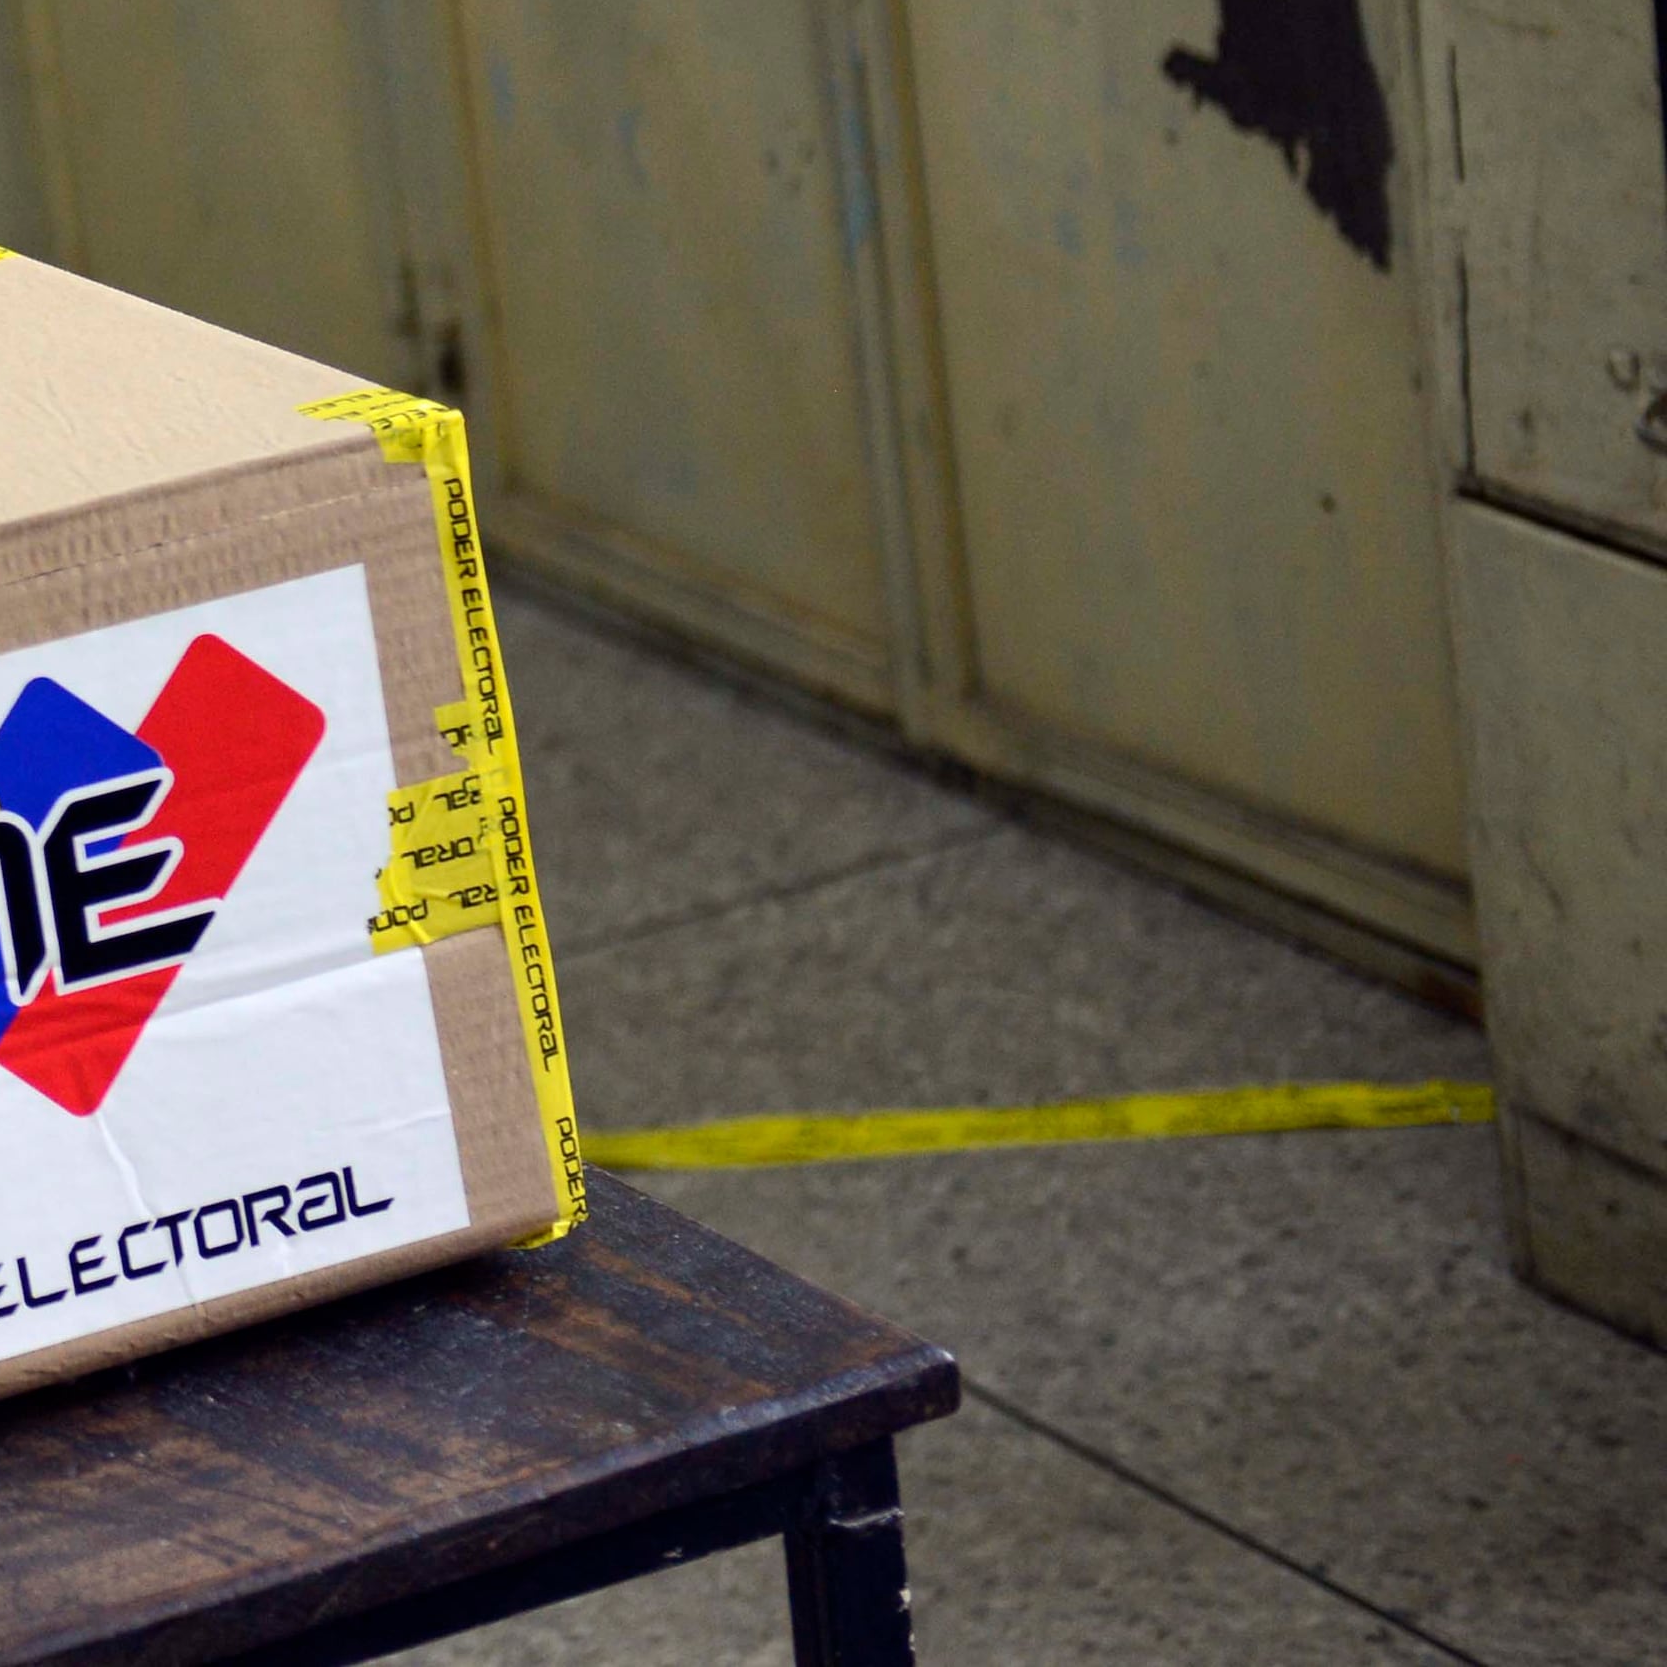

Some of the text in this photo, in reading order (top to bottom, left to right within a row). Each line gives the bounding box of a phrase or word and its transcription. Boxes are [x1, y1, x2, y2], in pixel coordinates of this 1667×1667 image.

[444, 477, 479, 579] PODER
[498, 796, 530, 897] PODER
[555, 1116, 587, 1222] PODER
